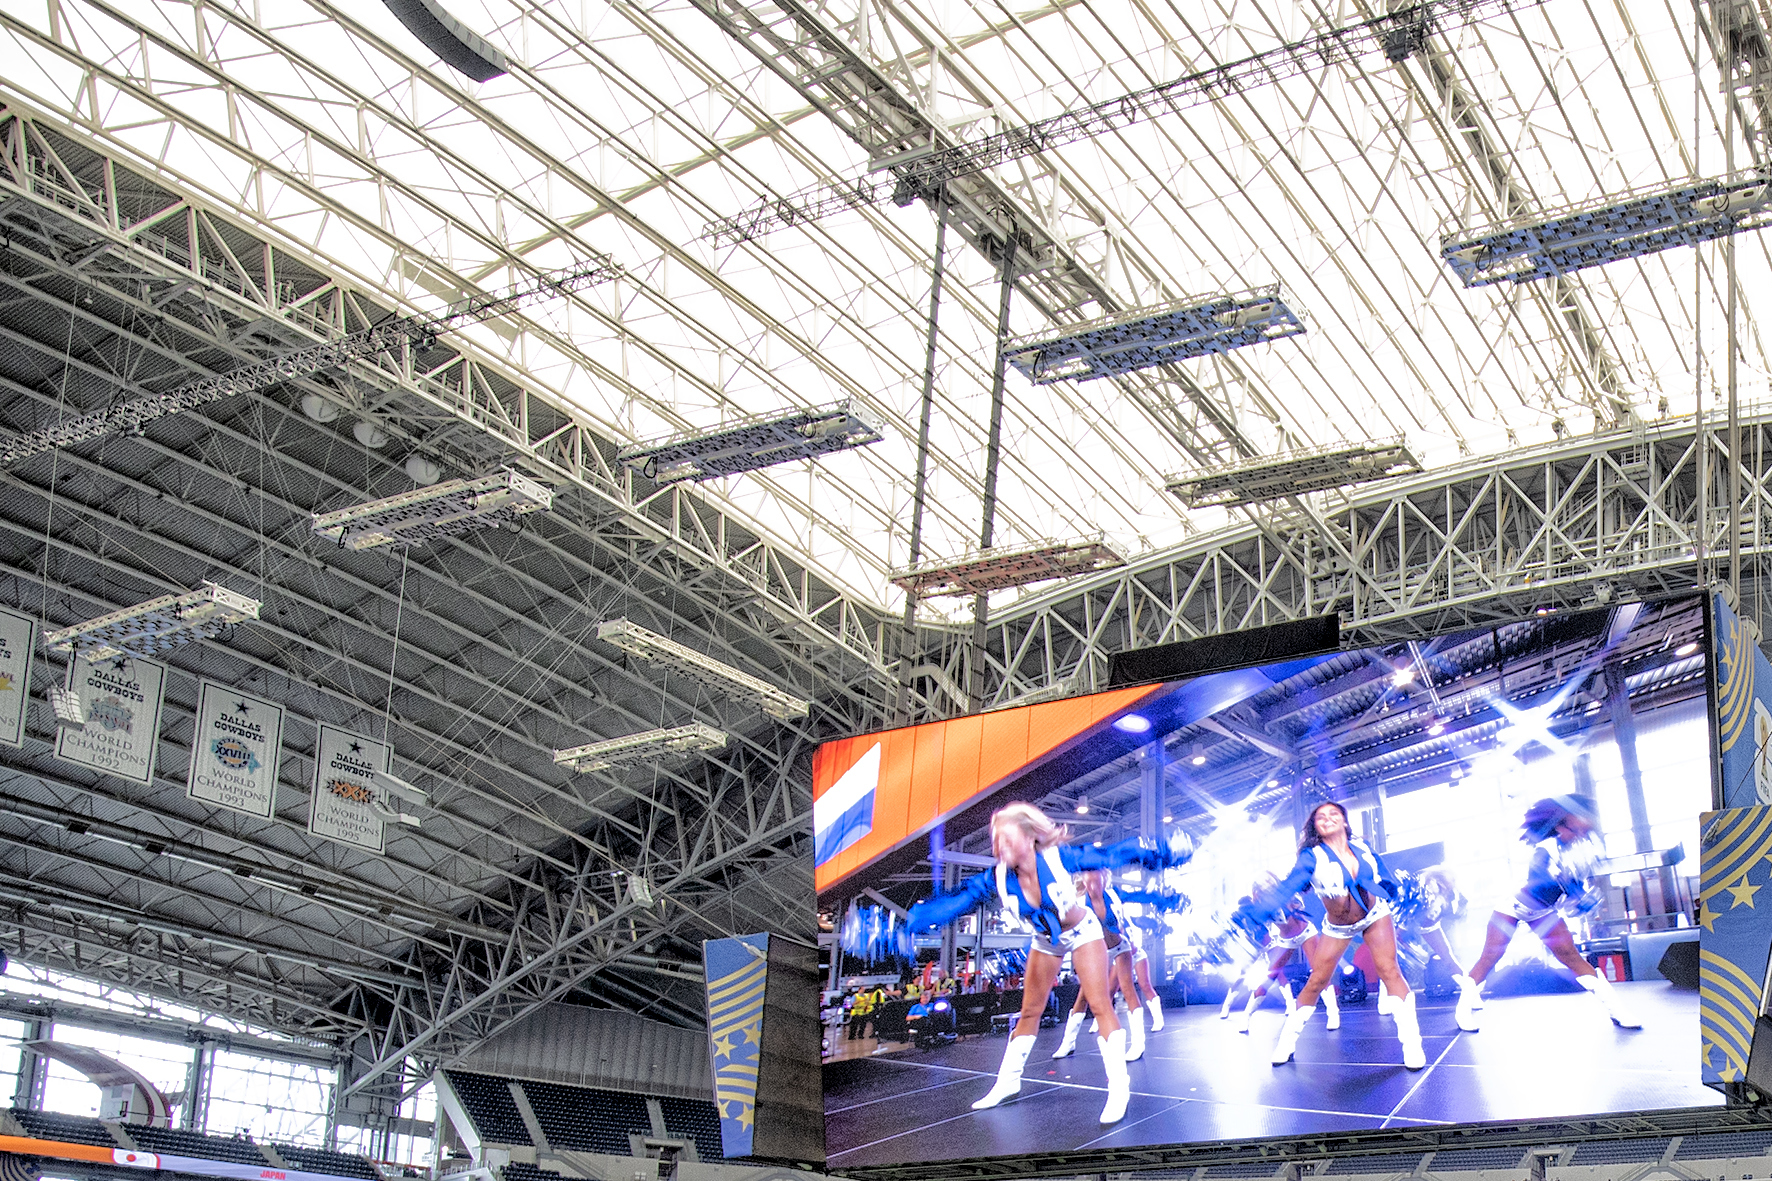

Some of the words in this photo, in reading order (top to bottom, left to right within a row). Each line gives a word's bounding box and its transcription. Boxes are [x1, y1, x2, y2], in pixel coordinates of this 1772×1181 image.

[87, 677, 144, 703] COWBOYS
[94, 669, 140, 691] DALLAS
[214, 721, 265, 743] COWBOYS
[220, 713, 261, 732] DALLAS
[84, 727, 133, 750] WORLD
[66, 733, 146, 766] CHAMPIONS
[91, 753, 120, 770] 1992
[336, 752, 373, 770] DALLAS
[212, 768, 256, 788] WORLD
[197, 775, 268, 803] CHAMPIONS
[333, 781, 369, 802] XXX
[218, 792, 245, 807] 1993
[330, 805, 369, 824] WORLD
[317, 813, 380, 837] CHAMPIONS
[336, 827, 360, 841] 1995
[260, 1170, 286, 1181] JAPAN
